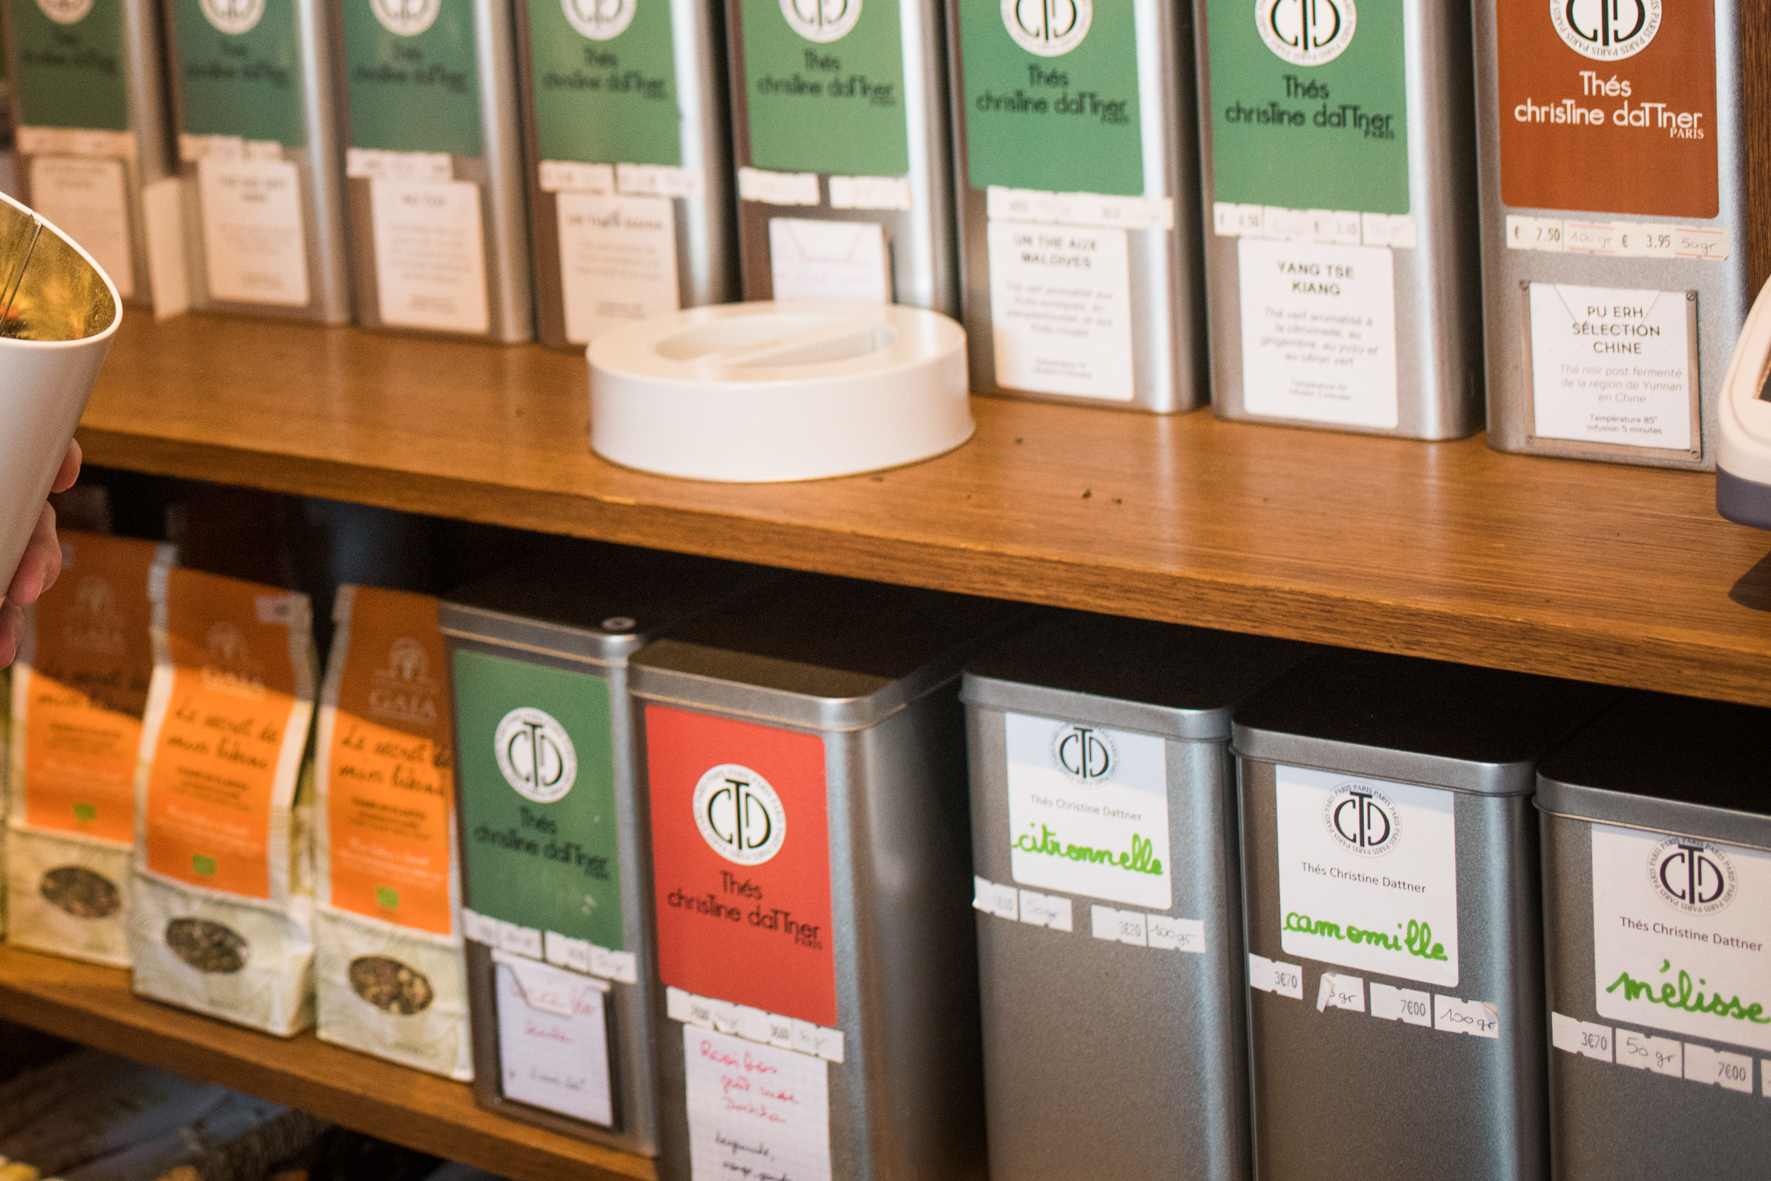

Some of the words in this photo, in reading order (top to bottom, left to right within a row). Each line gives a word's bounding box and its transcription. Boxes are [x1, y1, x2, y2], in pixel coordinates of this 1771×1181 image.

[1282, 74, 1329, 99] Thés
[1579, 71, 1632, 97] Thés
[1669, 127, 1704, 139] PARIS
[1536, 227, 1561, 242] 7.50
[1646, 234, 1671, 248] 3.95
[1021, 252, 1091, 268] MALDIVES
[1277, 261, 1320, 276] YANG
[1326, 264, 1355, 279] TSE
[1292, 282, 1341, 296] KIANG
[1587, 306, 1607, 319] PU
[1613, 306, 1643, 319] ERH
[1572, 322, 1660, 337] SÉLECTION
[1593, 342, 1642, 355] CHINE
[1561, 364, 1579, 374] Thé
[1582, 365, 1602, 376] noir
[1606, 367, 1628, 377] post
[1632, 366, 1682, 379] fermenté
[1561, 378, 1574, 388] de
[1577, 378, 1586, 388] la
[1589, 379, 1622, 391] région
[1625, 380, 1639, 390] de
[1643, 381, 1682, 391] Yunnan
[1598, 394, 1612, 403] en
[1614, 393, 1646, 404] Chine
[1589, 414, 1641, 425] Température
[1629, 425, 1662, 435] minutes
[1029, 794, 1053, 808] Thés
[1055, 798, 1100, 816] Christine
[1103, 803, 1143, 821] Dattner
[1011, 822, 1163, 875] citronnelle
[1301, 861, 1327, 876] Thés
[1329, 866, 1379, 886] Christine
[1382, 876, 1427, 894] Dattner
[1282, 911, 1448, 962] camomille
[1620, 916, 1649, 933] Thés
[1652, 922, 1709, 943] Christine
[1713, 933, 1763, 953] Dattner
[1275, 971, 1298, 989] 3€70
[1606, 958, 1771, 1025] mélisse
[1400, 999, 1426, 1017] 7€00
[1581, 1031, 1608, 1051] 3€70
[1717, 1062, 1747, 1083] 7€00
